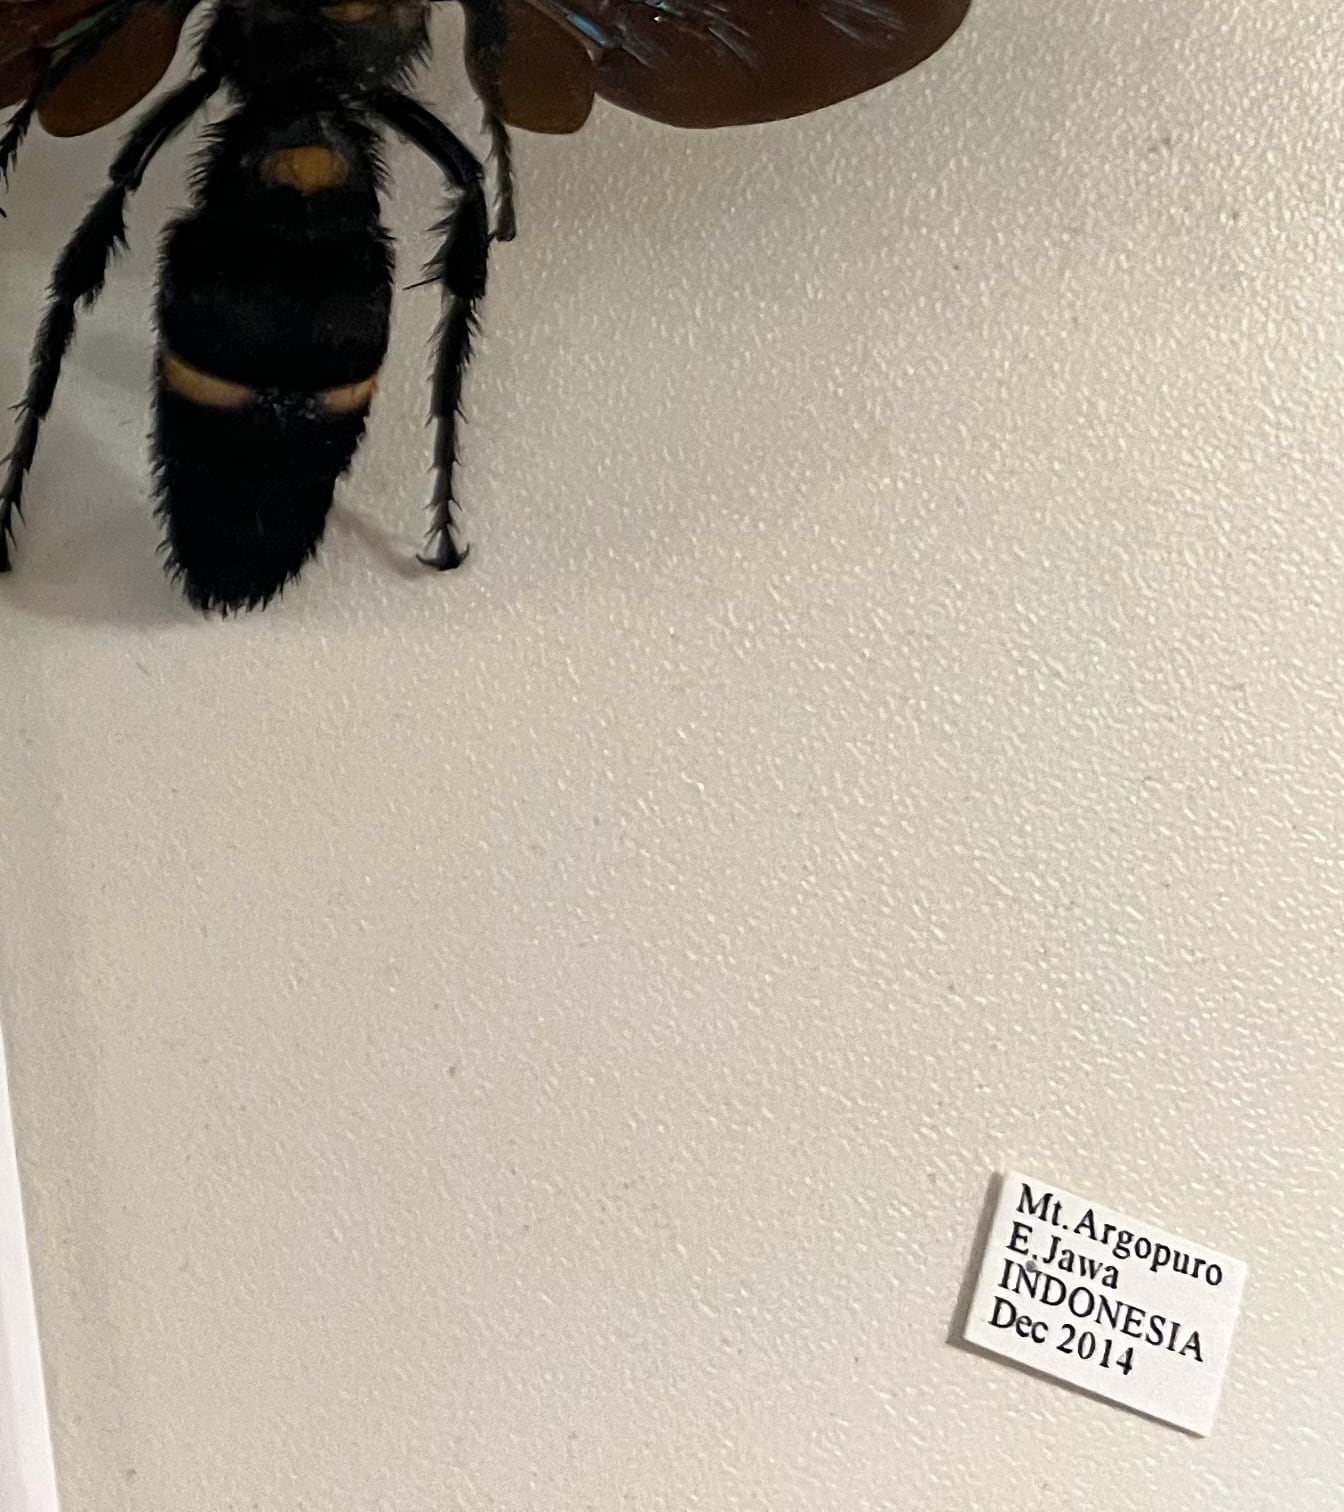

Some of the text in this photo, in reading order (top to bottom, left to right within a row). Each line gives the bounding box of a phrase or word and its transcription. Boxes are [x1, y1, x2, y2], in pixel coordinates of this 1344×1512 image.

[988, 1296, 1135, 1376] Dec 2014
[998, 1257, 1204, 1363] INDONESIA
